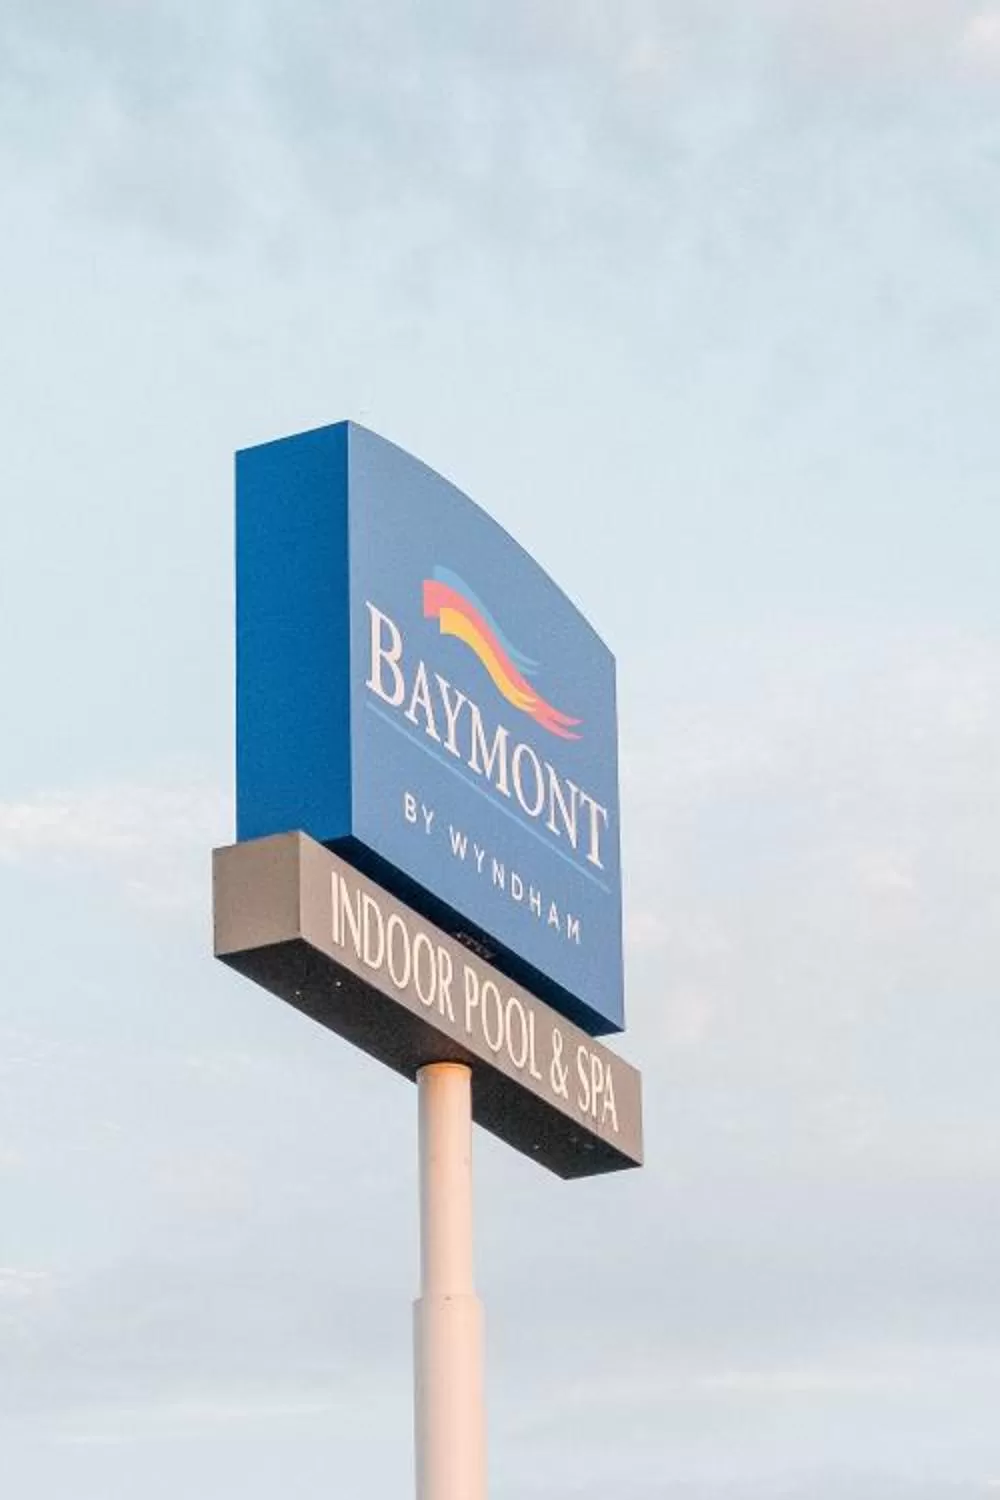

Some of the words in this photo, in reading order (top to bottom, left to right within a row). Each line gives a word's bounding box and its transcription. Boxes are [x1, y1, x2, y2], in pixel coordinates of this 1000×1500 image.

[365, 600, 610, 869] BAYMONT
[404, 792, 434, 834] BY
[449, 825, 582, 944] WYNDHAM
[330, 870, 456, 1022] INDOOR
[464, 967, 542, 1080] POOL
[551, 1027, 569, 1100] &
[577, 1045, 620, 1133] SPA
